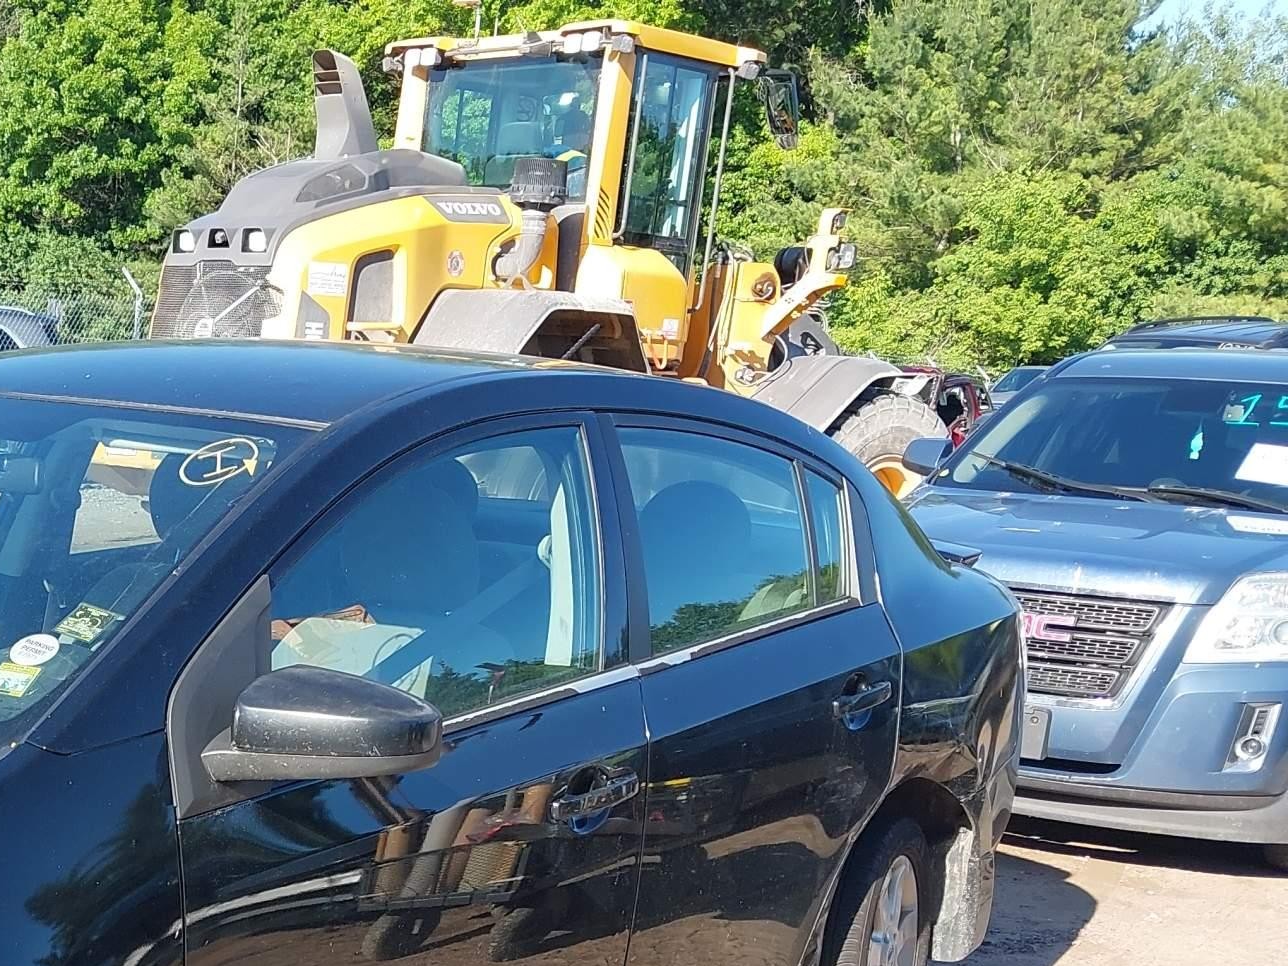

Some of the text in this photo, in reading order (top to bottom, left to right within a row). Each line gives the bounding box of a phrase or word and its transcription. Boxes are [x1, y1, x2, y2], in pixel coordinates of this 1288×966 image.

[436, 202, 501, 216] VOLVO
[20, 644, 47, 656] PERMIT
[24, 638, 55, 652] PARKING
